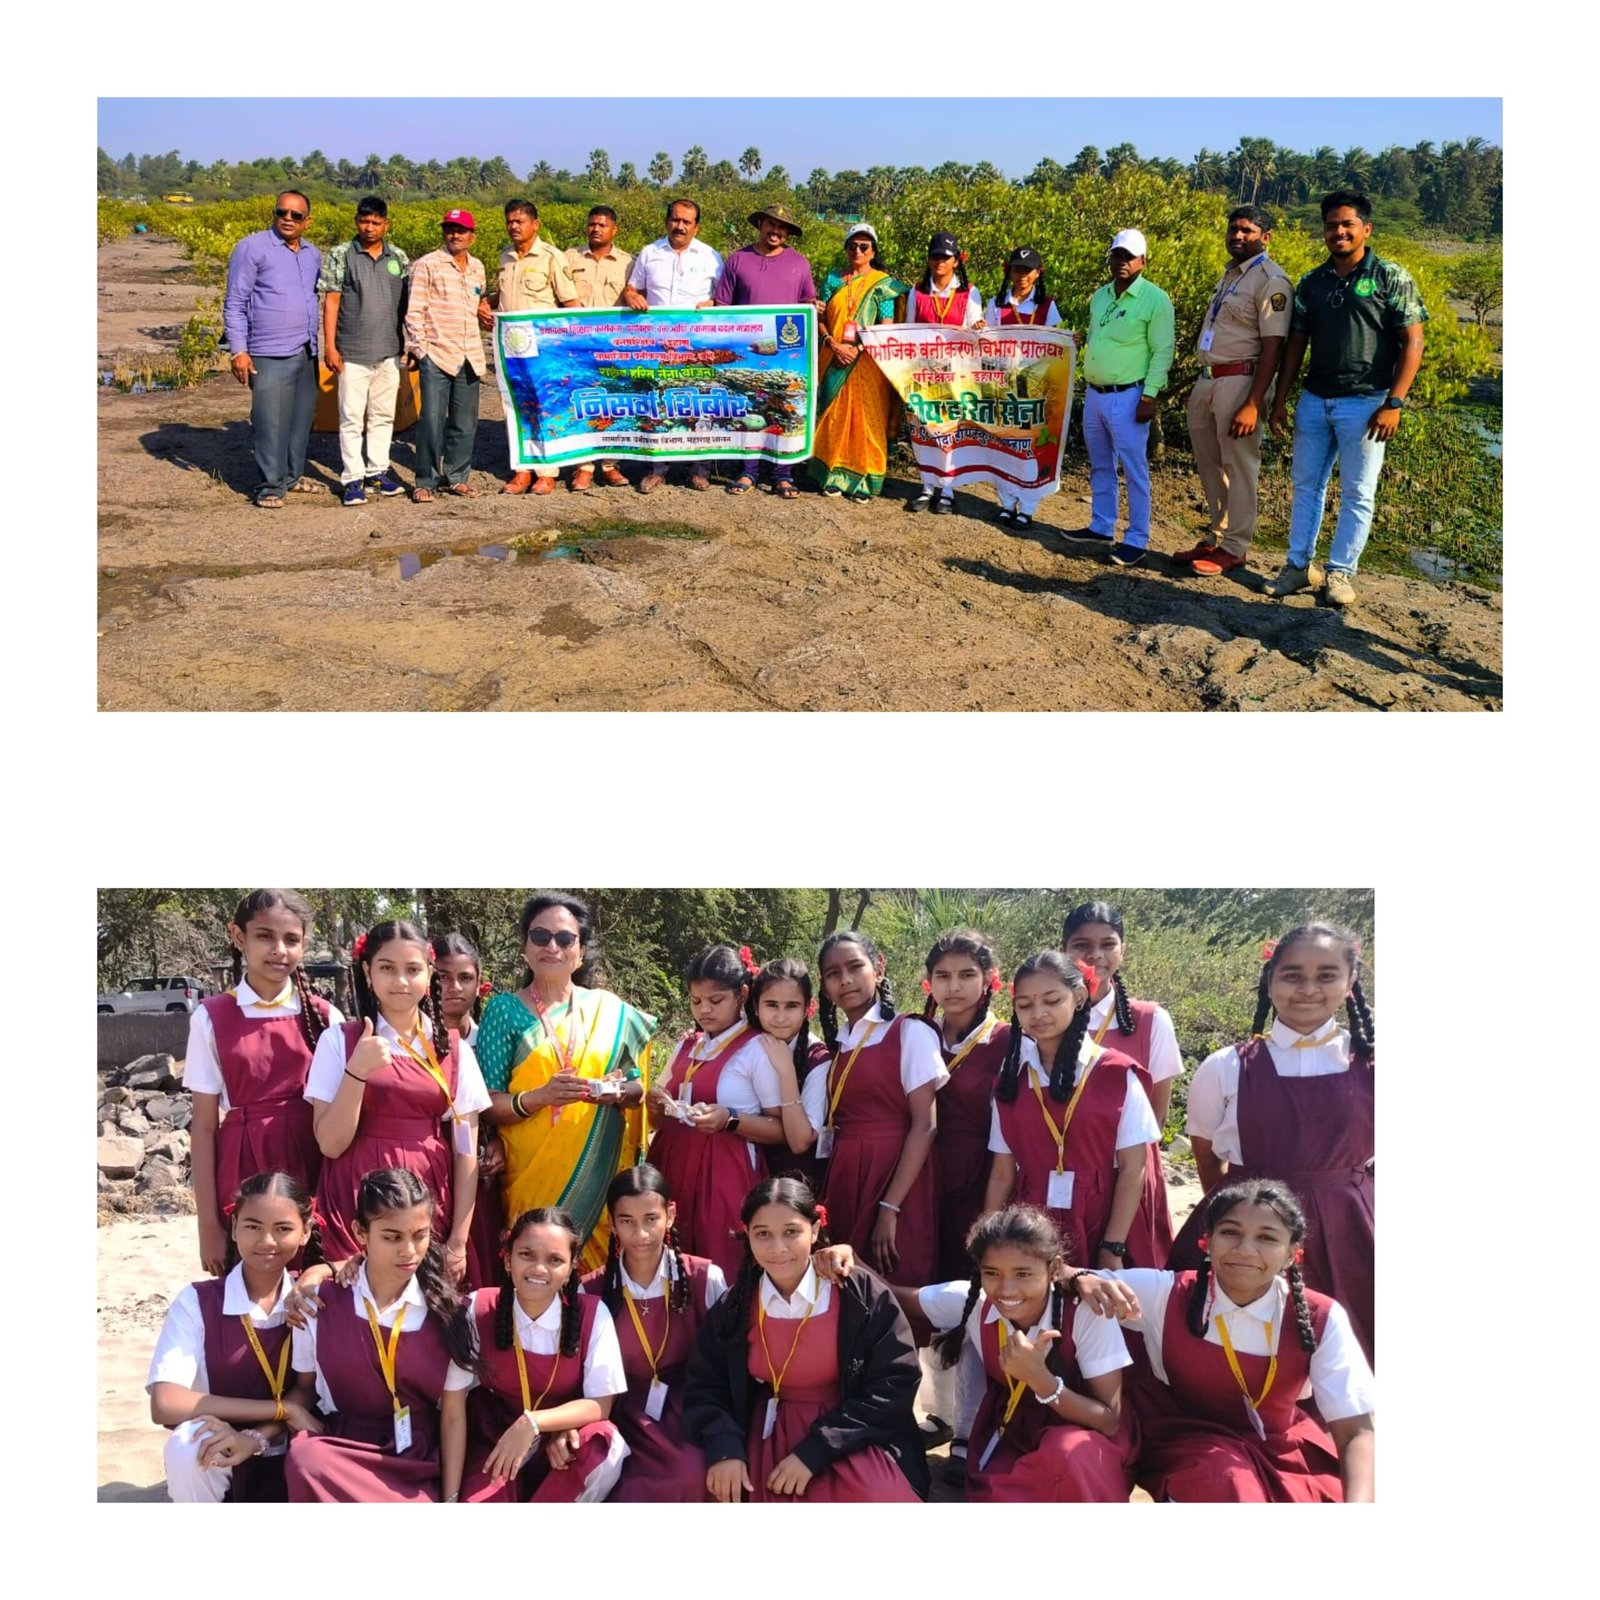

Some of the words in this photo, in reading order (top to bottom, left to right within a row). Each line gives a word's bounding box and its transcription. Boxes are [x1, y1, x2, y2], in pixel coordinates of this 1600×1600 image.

[919, 335, 974, 361] वनीकरण
[977, 337, 1017, 360] विभाग
[1020, 340, 1064, 361] पालघर
[912, 368, 955, 384] परिक्षेत्र
[971, 370, 1008, 388] डहाणू
[571, 387, 659, 420] निसर्ग
[662, 386, 748, 420] शिबीर
[945, 390, 994, 424] हरित
[1000, 392, 1046, 427] सेना
